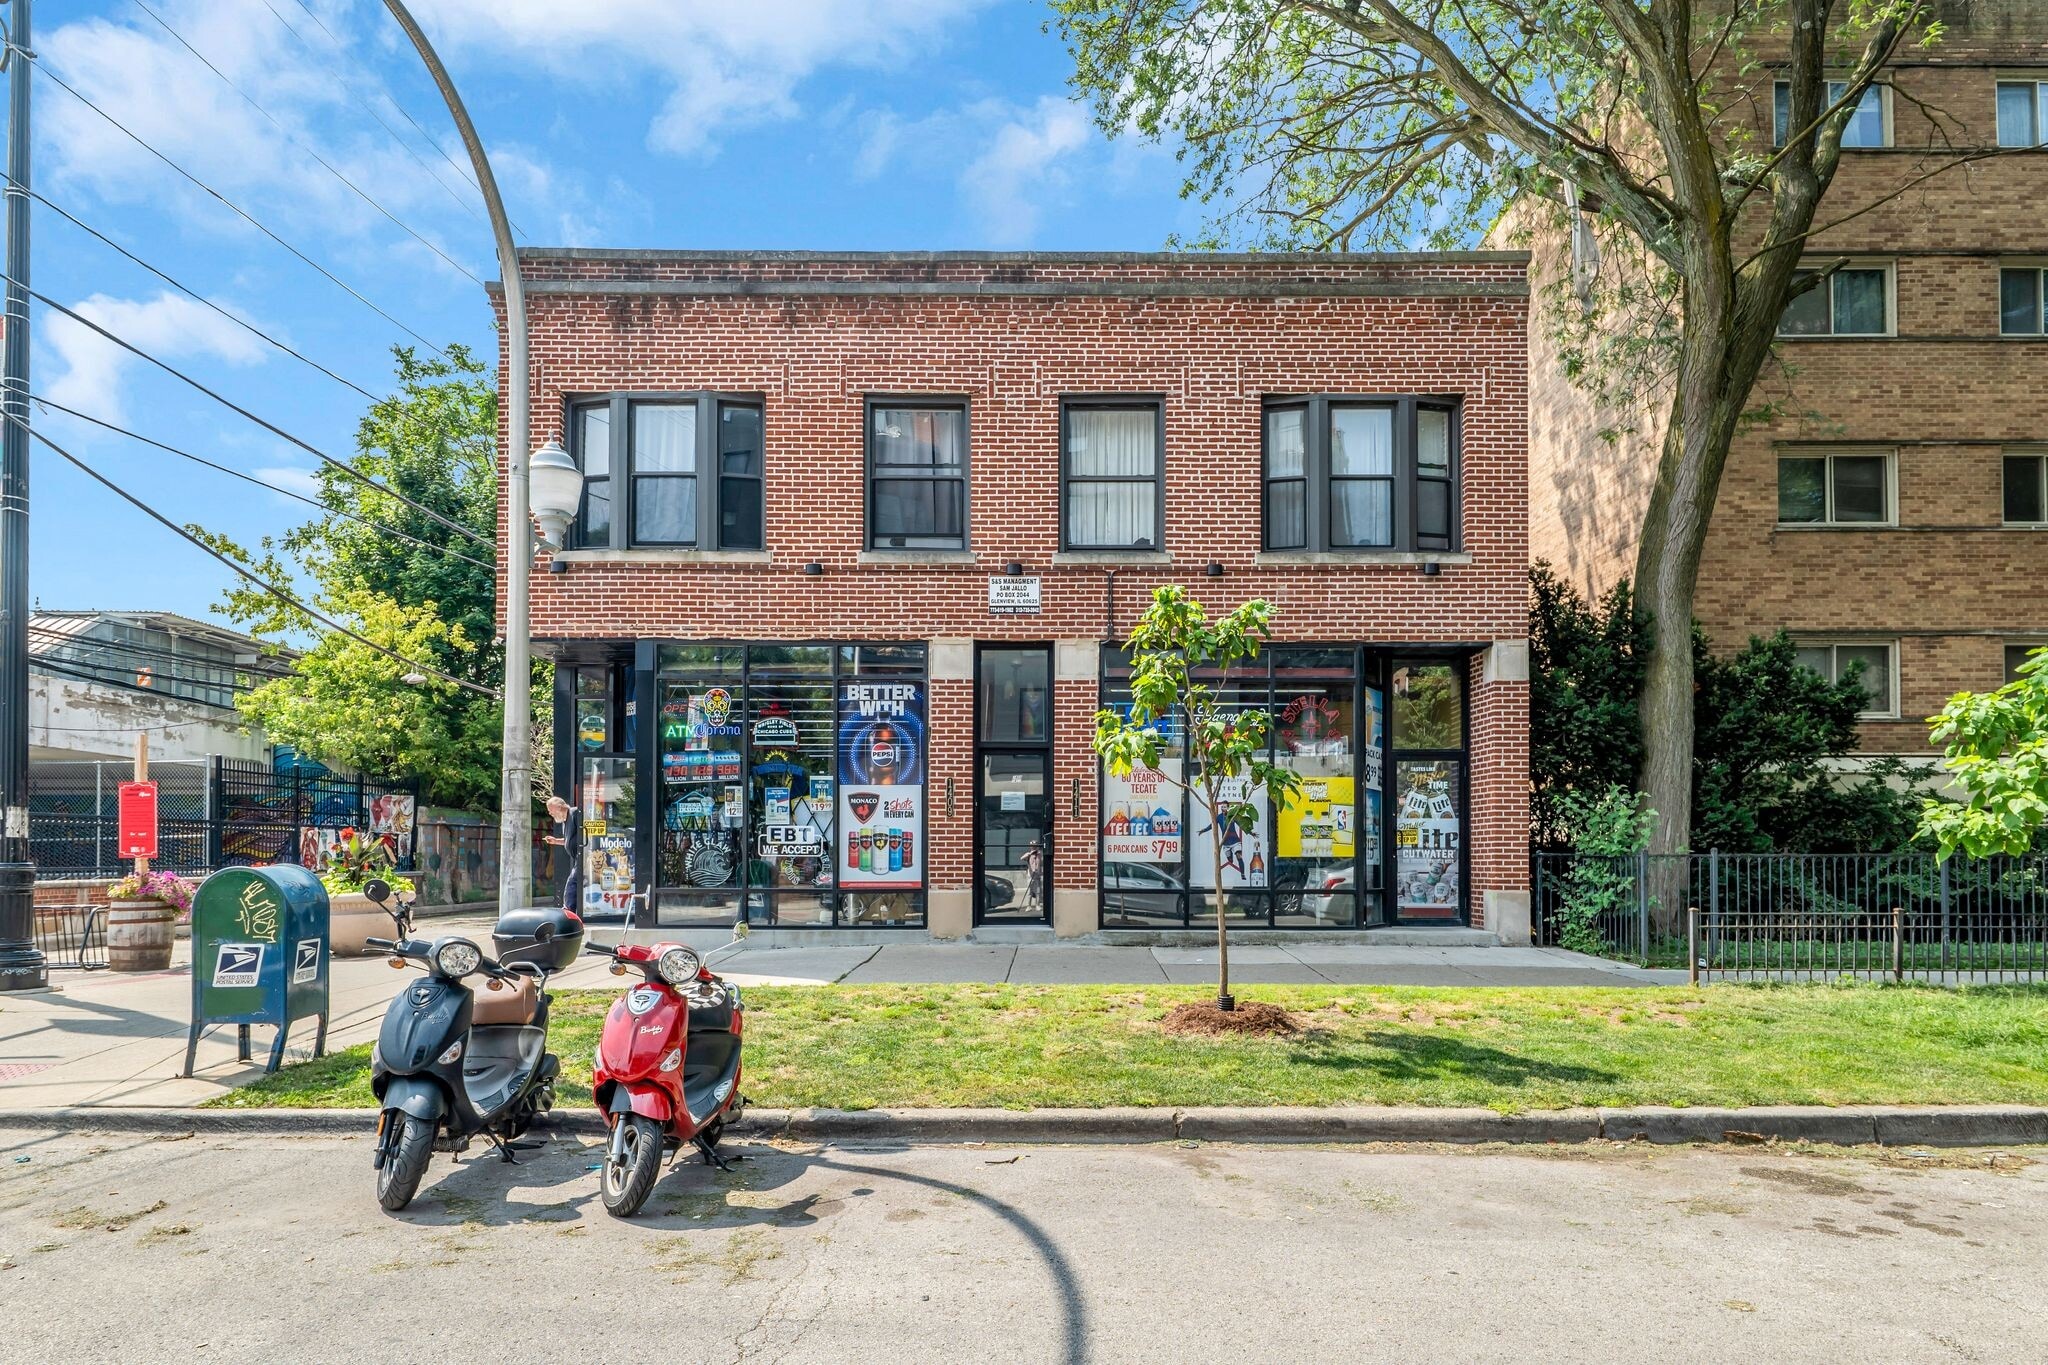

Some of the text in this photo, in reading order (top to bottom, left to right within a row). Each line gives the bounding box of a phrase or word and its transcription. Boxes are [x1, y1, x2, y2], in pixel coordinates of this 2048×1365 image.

[847, 684, 916, 700] BETTER
[859, 700, 905, 716] WITH
[1282, 695, 1340, 724] STELLA
[666, 725, 701, 738] ATM
[695, 723, 741, 739] Corona
[1133, 773, 1156, 783] YEARS
[1131, 784, 1157, 793] TECATE
[1429, 781, 1449, 789] TIME
[884, 797, 913, 810] 2 Shots
[905, 810, 915, 818] CAN
[770, 828, 811, 842] EBT
[600, 837, 632, 848] Modelo
[685, 837, 732, 869] WHITE CLAW
[762, 845, 819, 854] WE ACCEPT
[1107, 845, 1148, 853] 6 PACK CANS
[1402, 849, 1454, 858] CUTWATER
[640, 1025, 664, 1034] Buddy
